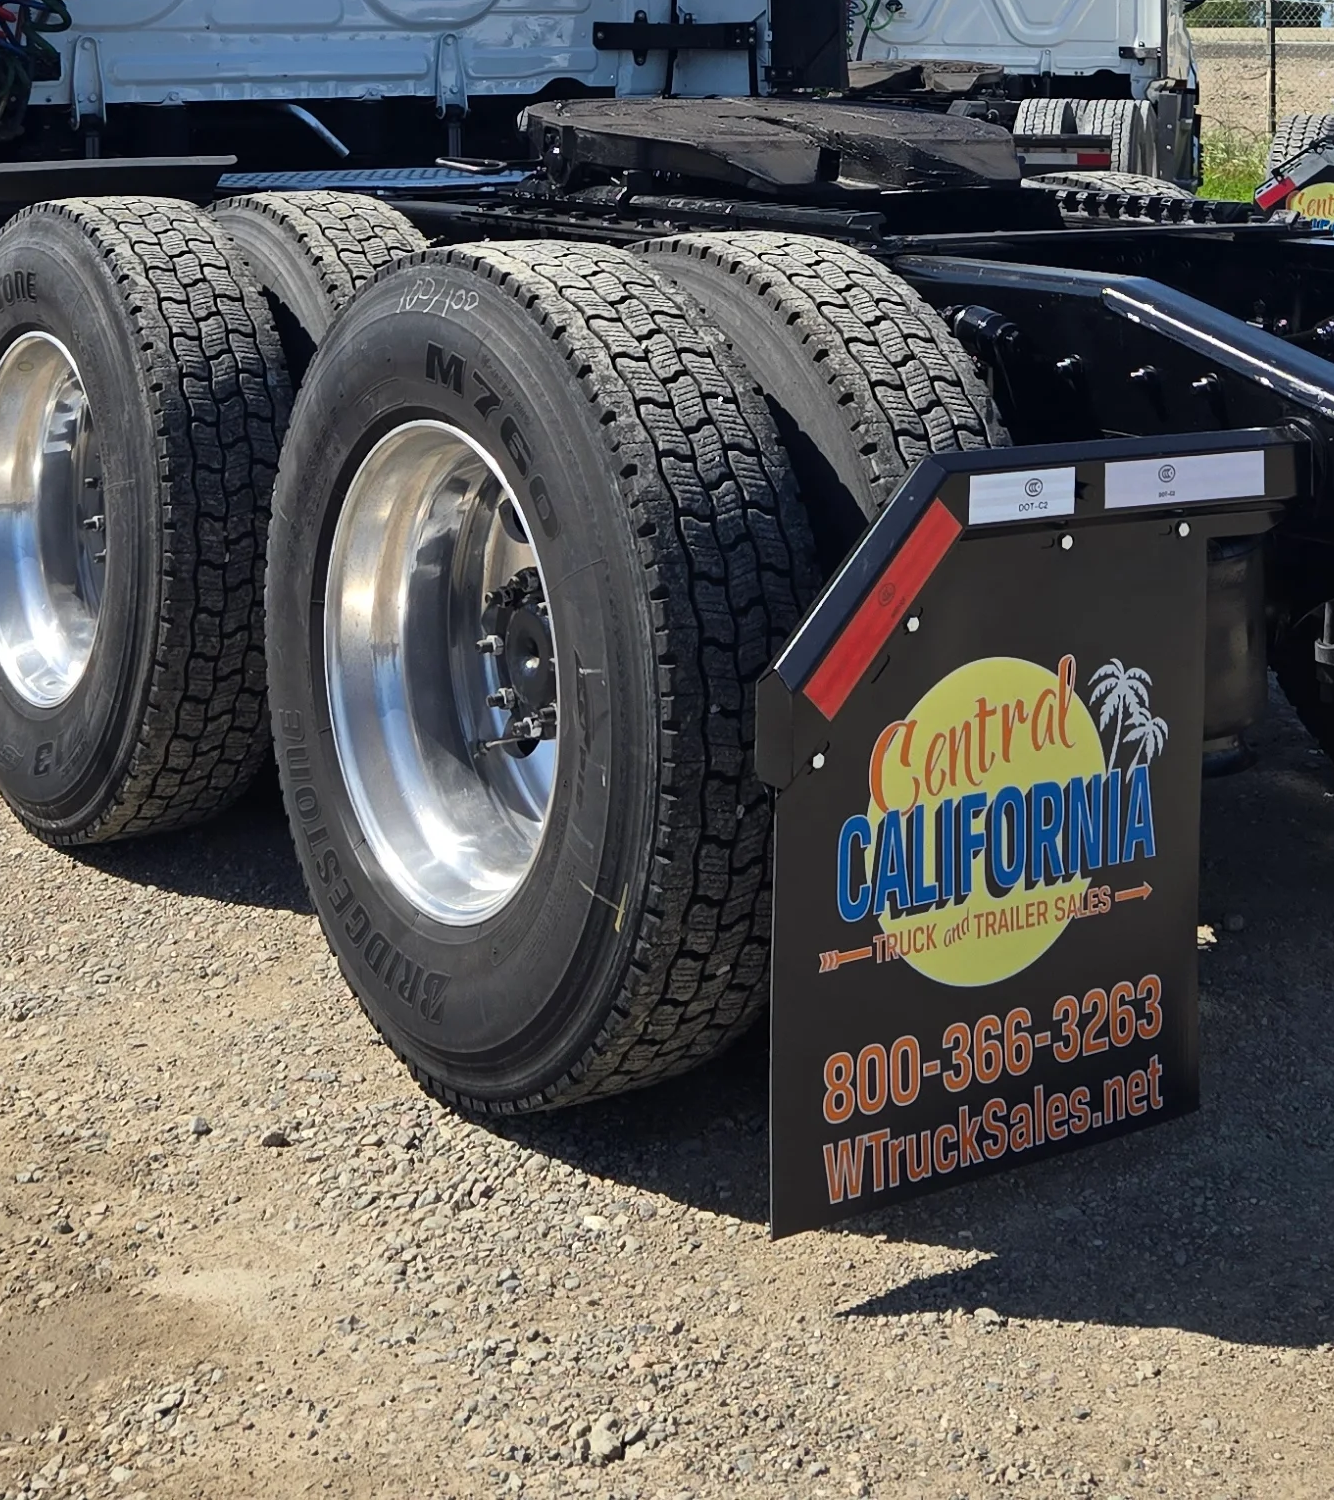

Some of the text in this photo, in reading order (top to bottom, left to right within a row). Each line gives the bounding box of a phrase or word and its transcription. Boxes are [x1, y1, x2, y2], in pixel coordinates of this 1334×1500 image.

[425, 340, 561, 541] M760
[1018, 501, 1049, 512] DOT-C2
[869, 653, 1077, 817] Central
[278, 708, 452, 1025] BRIDGESTONE
[836, 763, 1157, 924] CALIFORNIA
[873, 885, 1113, 964] TRUCK and TRAILER SALES
[823, 974, 1163, 1125] 800-366-3263
[823, 1053, 1164, 1205] WTruckSales.net
